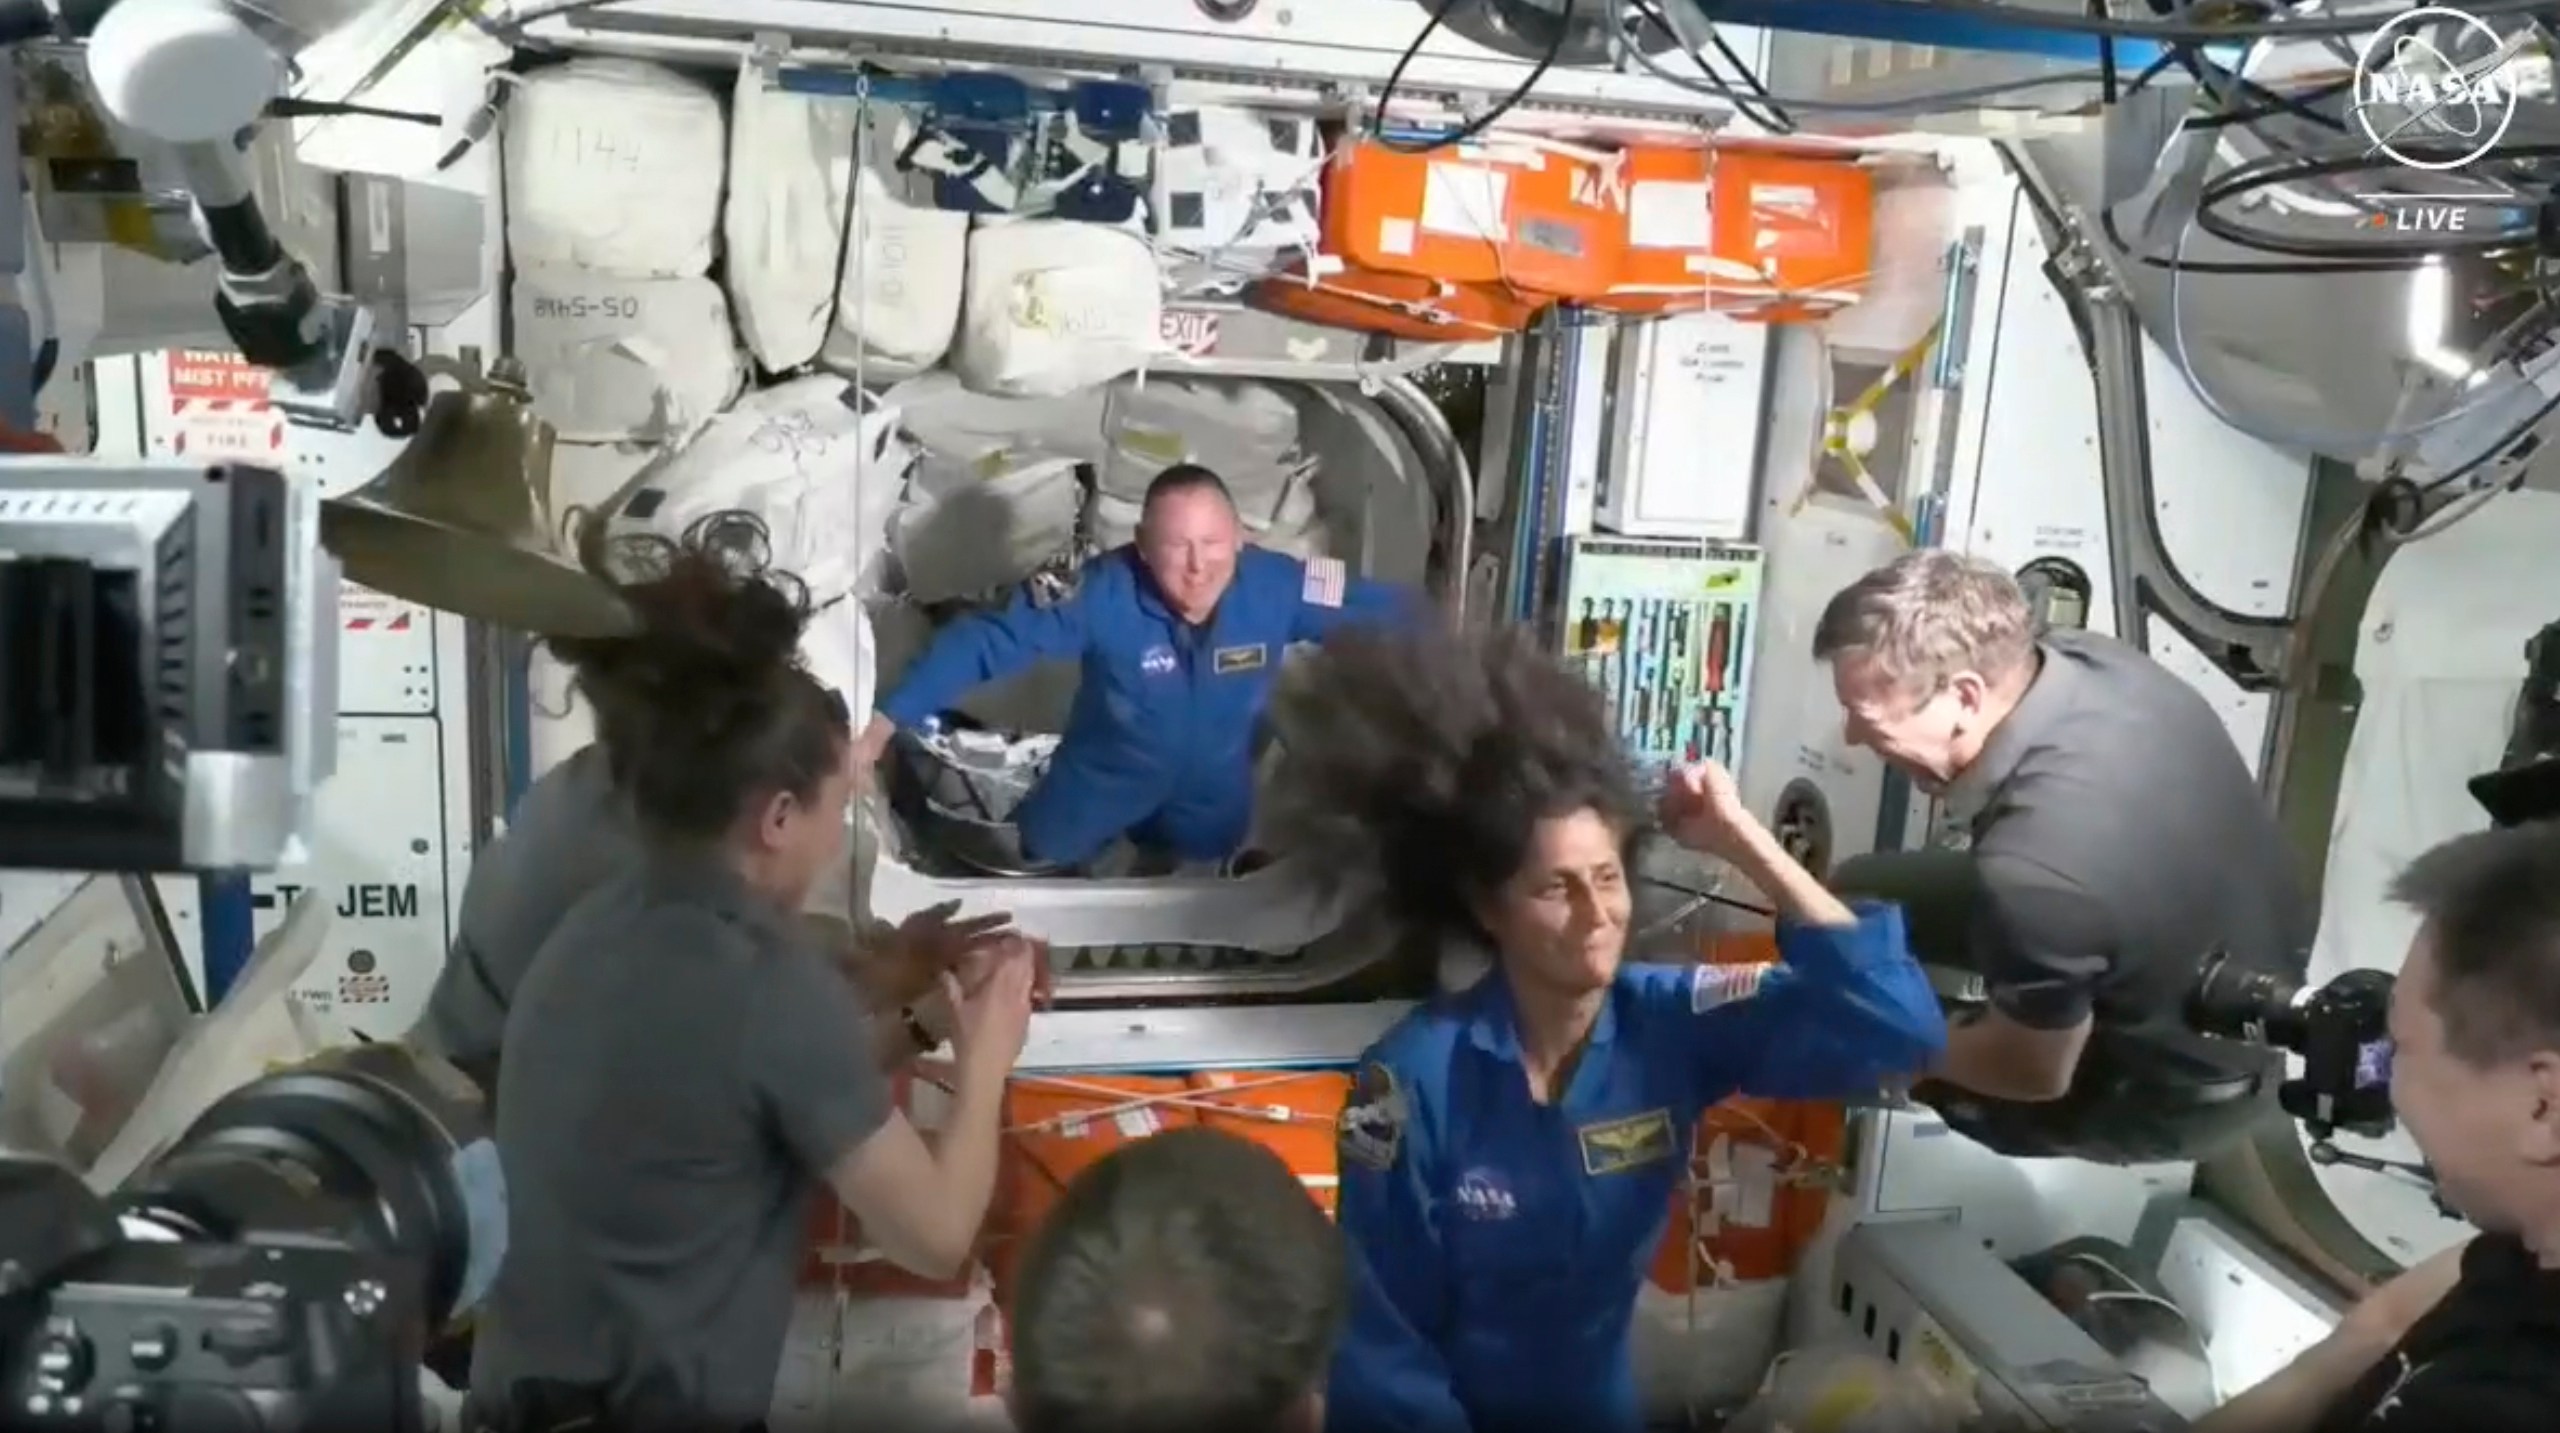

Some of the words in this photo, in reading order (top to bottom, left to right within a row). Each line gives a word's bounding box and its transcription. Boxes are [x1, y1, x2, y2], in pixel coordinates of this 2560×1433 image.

[1158, 311, 1206, 341] EXIT
[173, 366, 225, 388] MIST
[336, 884, 419, 918] JEM
